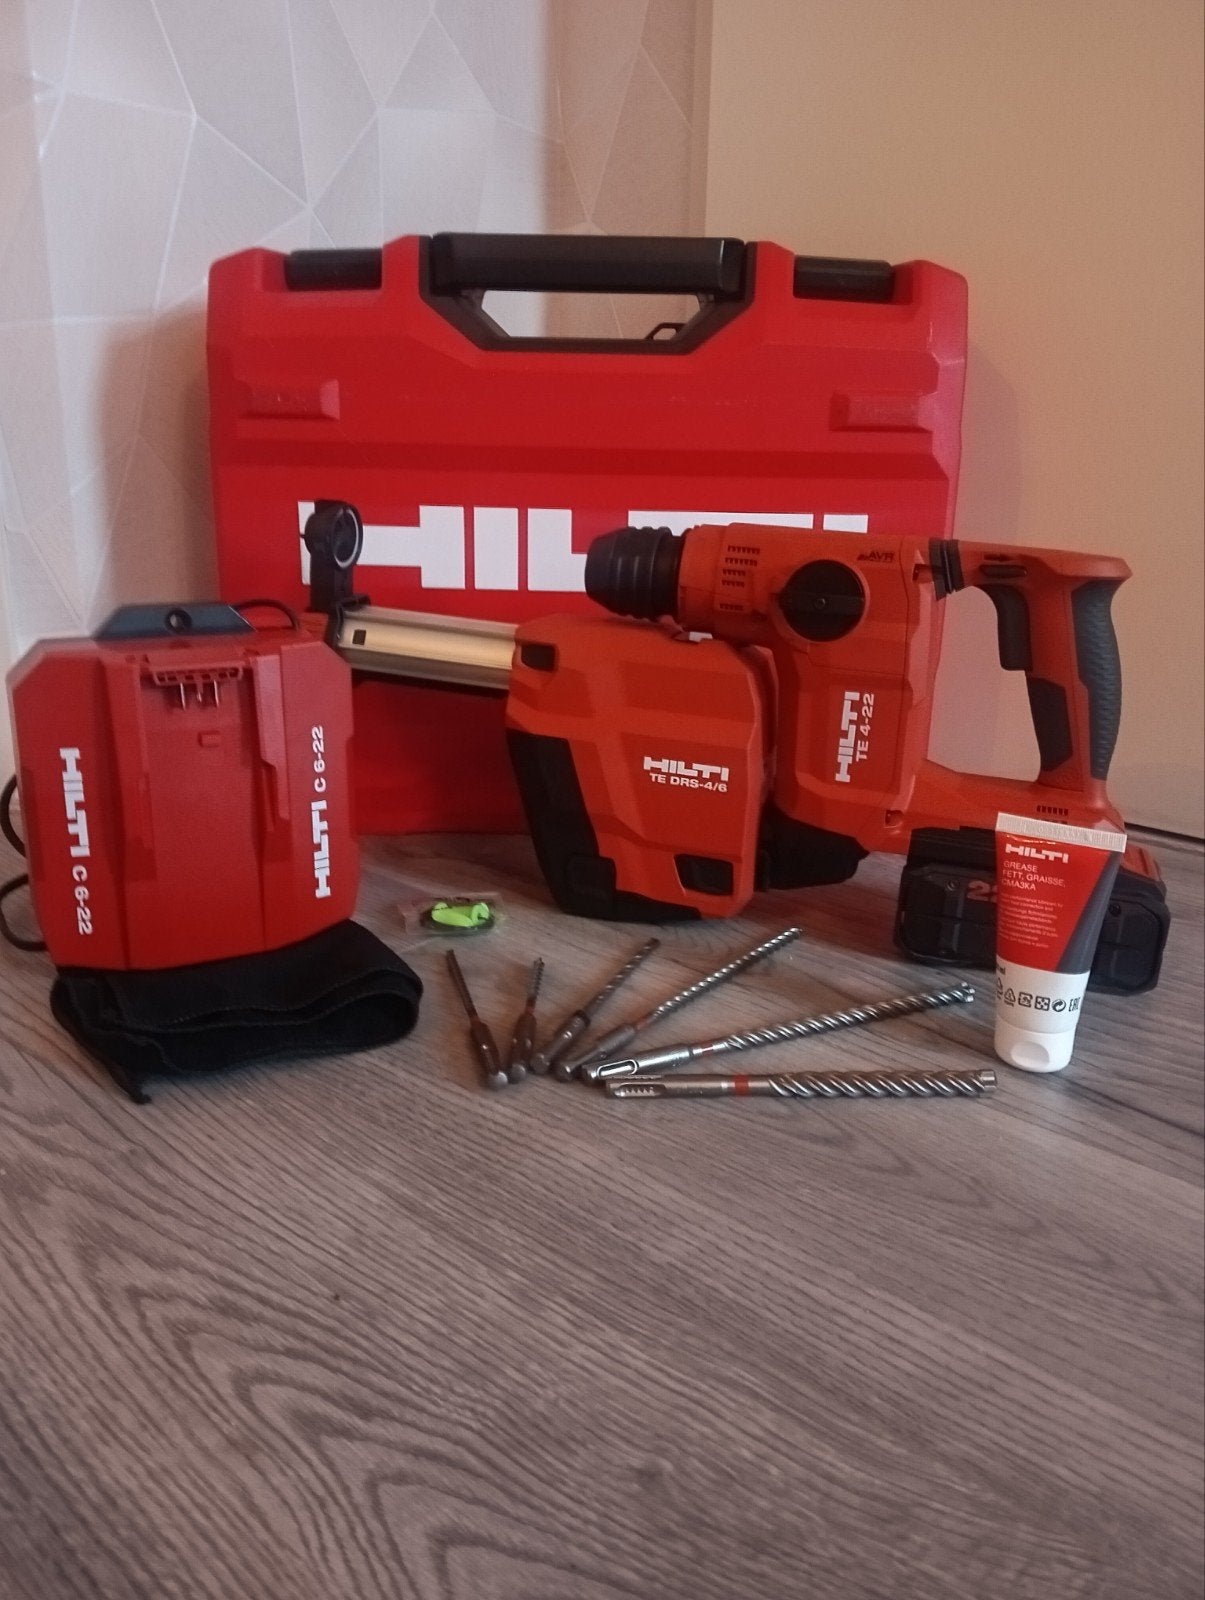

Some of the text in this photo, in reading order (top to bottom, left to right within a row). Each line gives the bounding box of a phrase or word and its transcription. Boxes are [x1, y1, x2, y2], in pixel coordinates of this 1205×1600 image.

[298, 501, 868, 592] HIL
[835, 691, 860, 783] HILTI
[855, 693, 875, 762] TE 4-22
[643, 756, 730, 782] HILTI
[649, 772, 728, 793] TE DRS-4/6
[59, 747, 93, 936] HILTI C 6-22
[311, 725, 331, 899] HILTI C 6-22
[1003, 861, 1038, 873] GREASE
[1005, 843, 1069, 864] HILTI
